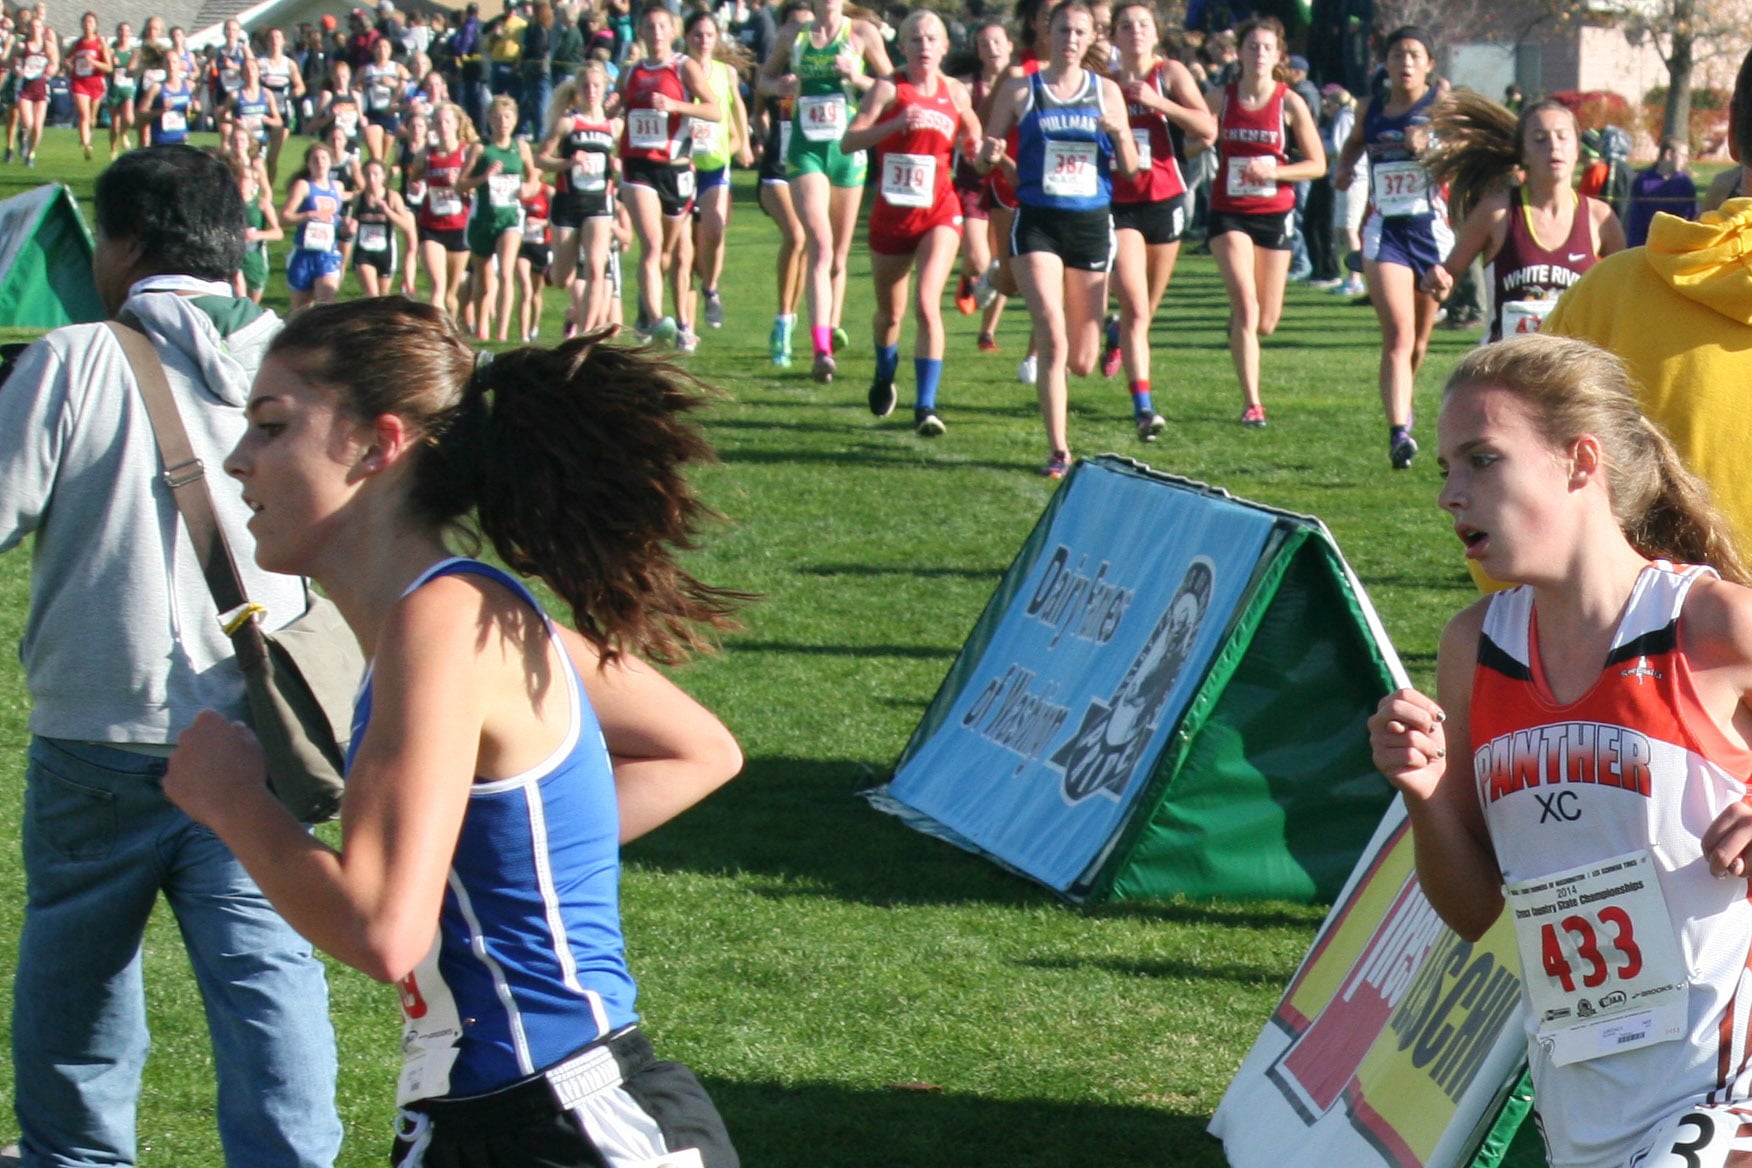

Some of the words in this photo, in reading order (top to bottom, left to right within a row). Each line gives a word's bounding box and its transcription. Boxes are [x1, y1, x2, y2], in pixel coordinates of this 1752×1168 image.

[809, 103, 837, 122] 429
[1039, 115, 1097, 132] PULLMAN
[1223, 129, 1279, 144] CHENEY
[1055, 153, 1088, 174] 387
[893, 166, 924, 186] 319
[1384, 174, 1417, 195] 372
[1504, 264, 1549, 291] WHITE
[1475, 722, 1652, 807] PANTHER
[1535, 791, 1582, 824] XC
[1532, 903, 1557, 918] Country
[1557, 898, 1578, 911] State
[1579, 880, 1644, 905] Championships
[1556, 885, 1577, 898] 2014
[1541, 906, 1643, 992] 433
